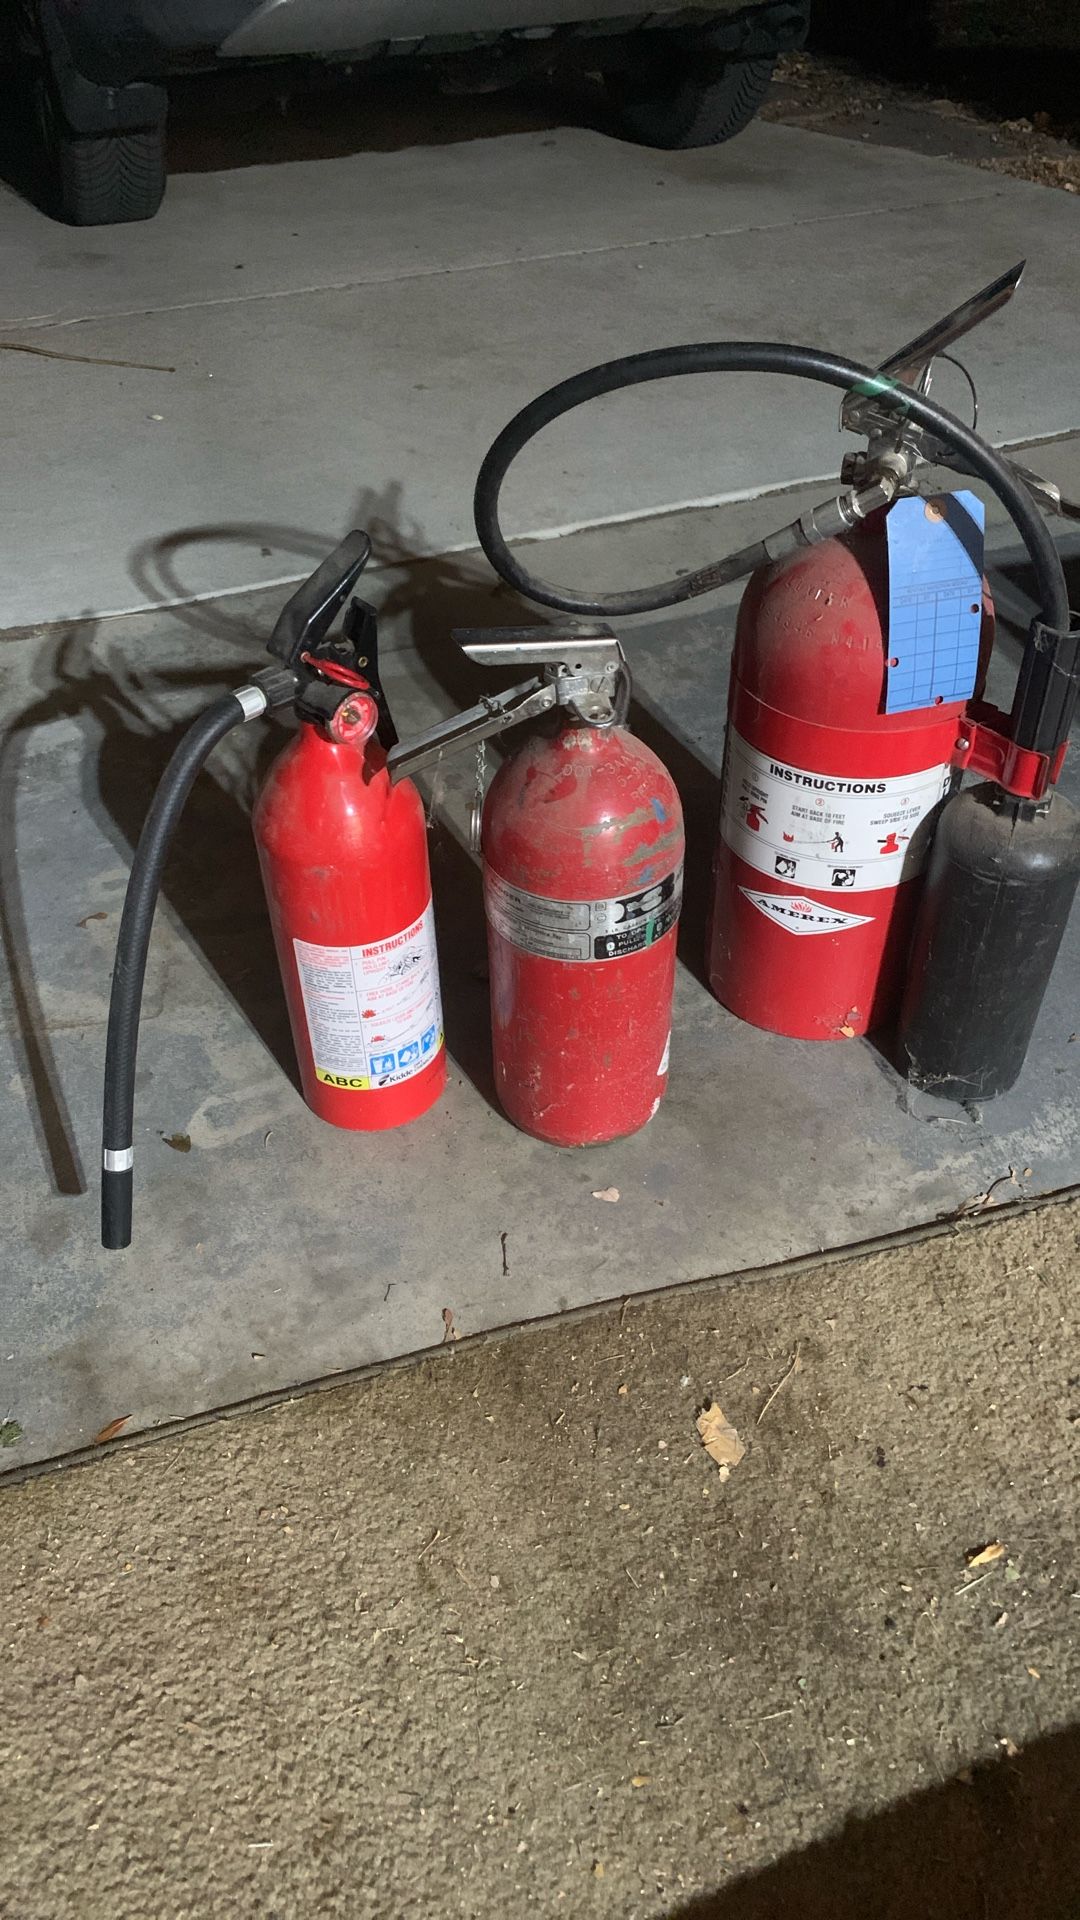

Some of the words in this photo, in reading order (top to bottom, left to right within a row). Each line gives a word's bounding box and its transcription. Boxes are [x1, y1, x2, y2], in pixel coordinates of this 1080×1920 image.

[769, 763, 886, 794] INSTRUCTIONS
[792, 804, 809, 813] START
[883, 809, 906, 818] SQUEEZE
[906, 806, 921, 814] LEVER
[791, 811, 801, 819] AIM
[909, 811, 920, 819] SIDE
[757, 899, 848, 924] AMEREX
[362, 919, 423, 958] INSTRUCTIONS
[616, 931, 628, 940] TO
[618, 937, 640, 947] PULL
[323, 1073, 363, 1087] ABC
[389, 1069, 413, 1082] Kidde
